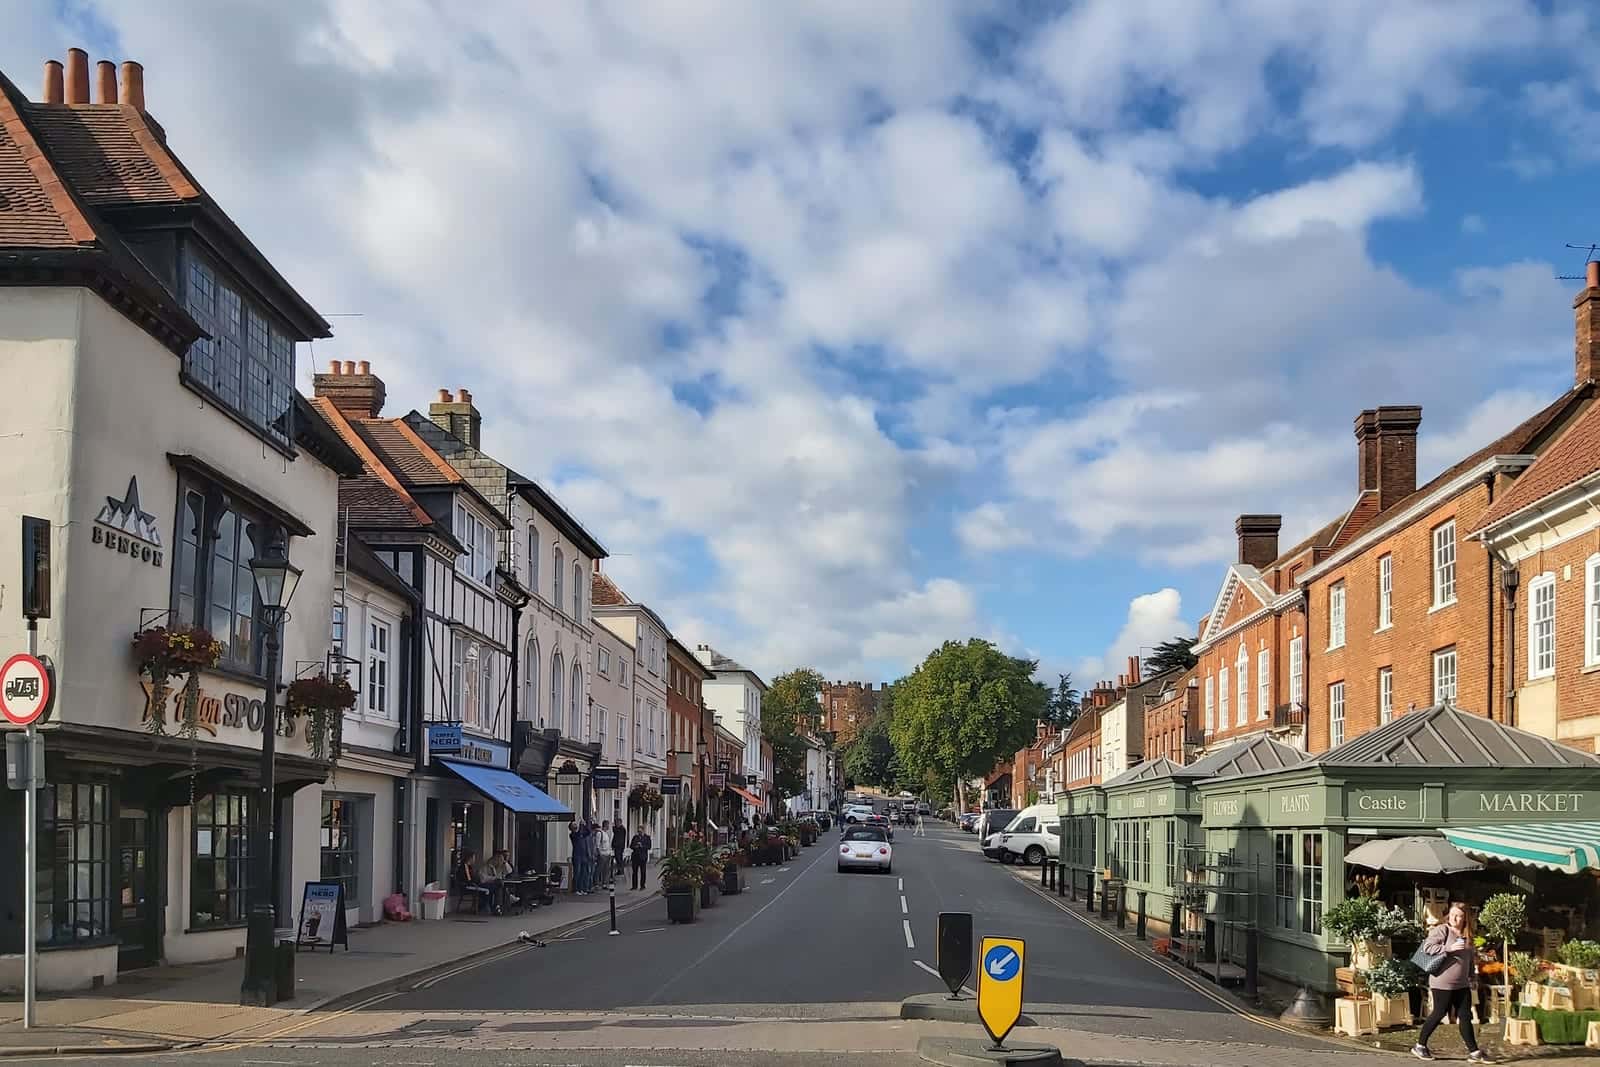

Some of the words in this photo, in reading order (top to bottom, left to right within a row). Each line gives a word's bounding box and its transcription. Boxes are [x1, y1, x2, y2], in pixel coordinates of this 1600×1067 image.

[92, 526, 163, 568] BENSON
[223, 693, 296, 737] SPOTS
[1213, 800, 1238, 816] FLOWERS
[1281, 794, 1310, 813] PLANTS
[1359, 795, 1407, 810] Castle
[1479, 793, 1583, 812] MARKET
